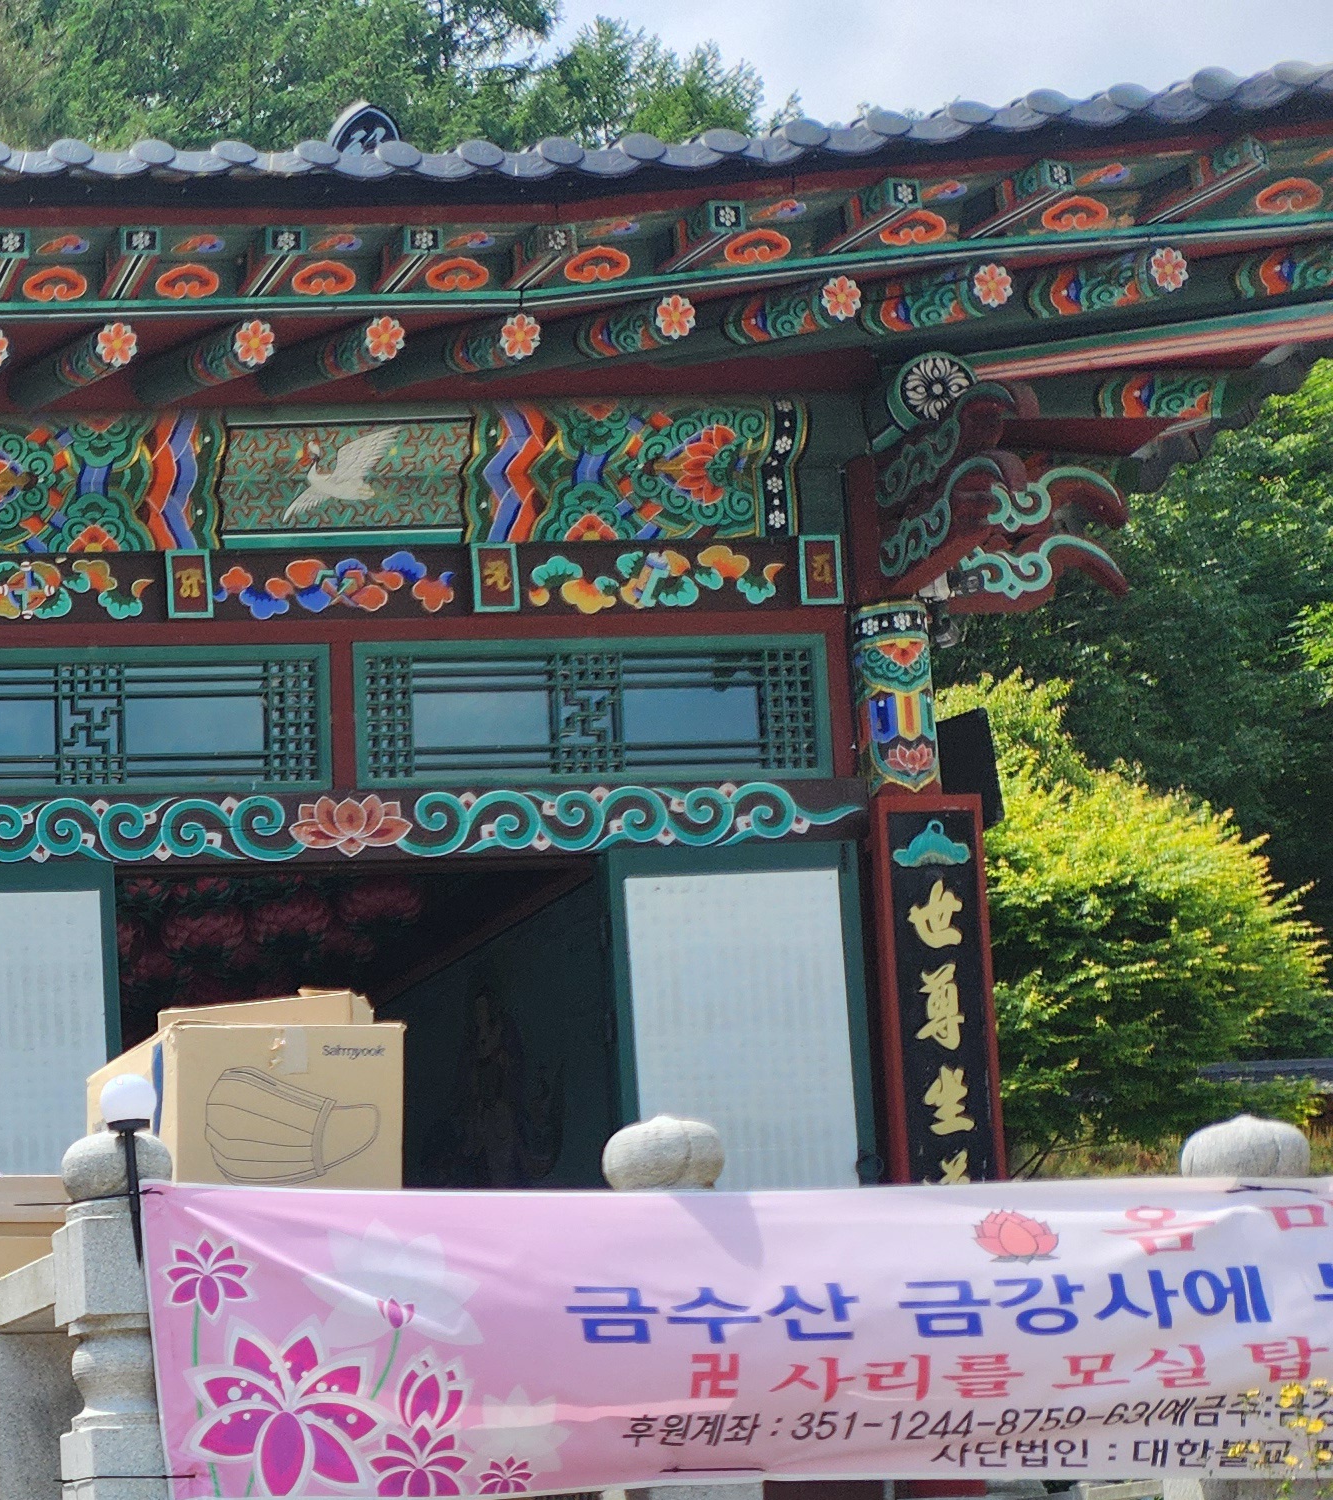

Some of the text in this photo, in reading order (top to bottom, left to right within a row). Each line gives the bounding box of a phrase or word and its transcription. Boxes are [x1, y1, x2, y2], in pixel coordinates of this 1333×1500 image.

[1101, 1205, 1216, 1256] 옴
[565, 1281, 861, 1345] 금수산
[898, 1264, 1273, 1338] 금강사에
[768, 1353, 1025, 1402] 사리를
[1050, 1343, 1212, 1389] 모실
[621, 1410, 763, 1448] 후원계좌
[930, 1438, 1089, 1469] 사단법인
